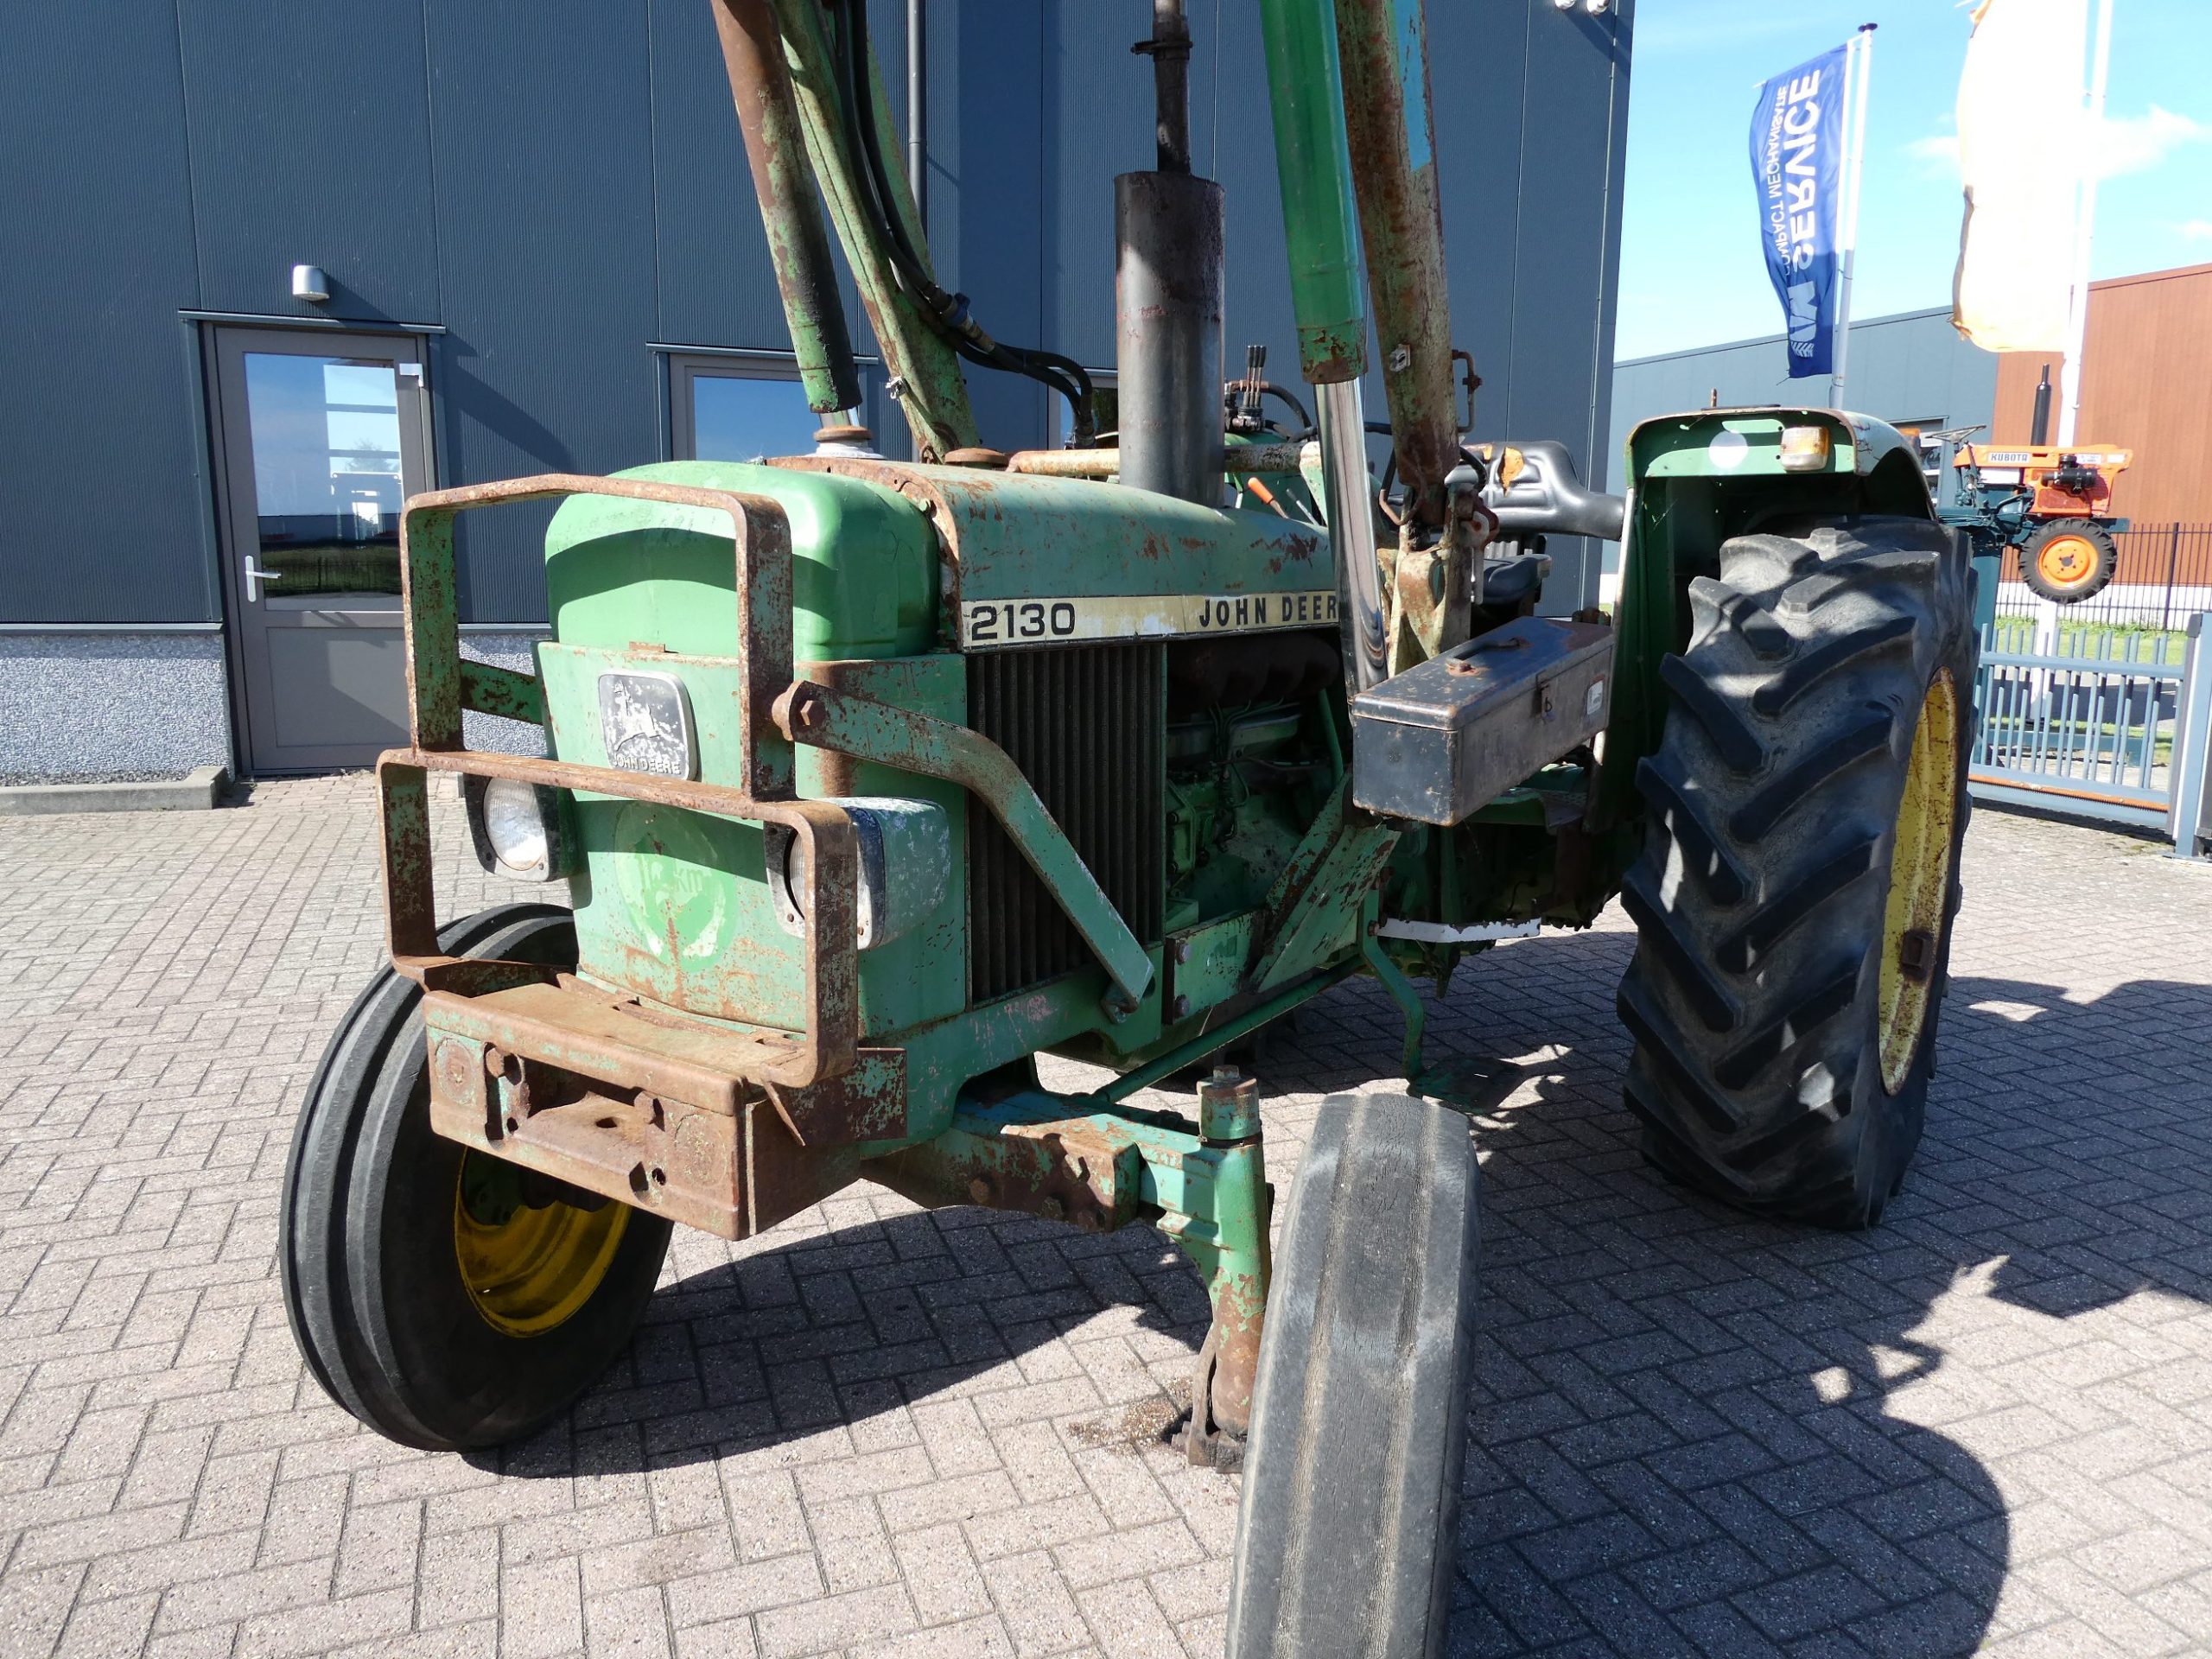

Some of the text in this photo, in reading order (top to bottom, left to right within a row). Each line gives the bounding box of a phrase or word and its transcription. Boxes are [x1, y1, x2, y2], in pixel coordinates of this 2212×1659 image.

[1990, 453, 2029, 462] KUBOTA
[971, 594, 1338, 641] 2130 JOHN DEER
[613, 753, 682, 775] JOHN DEERE
